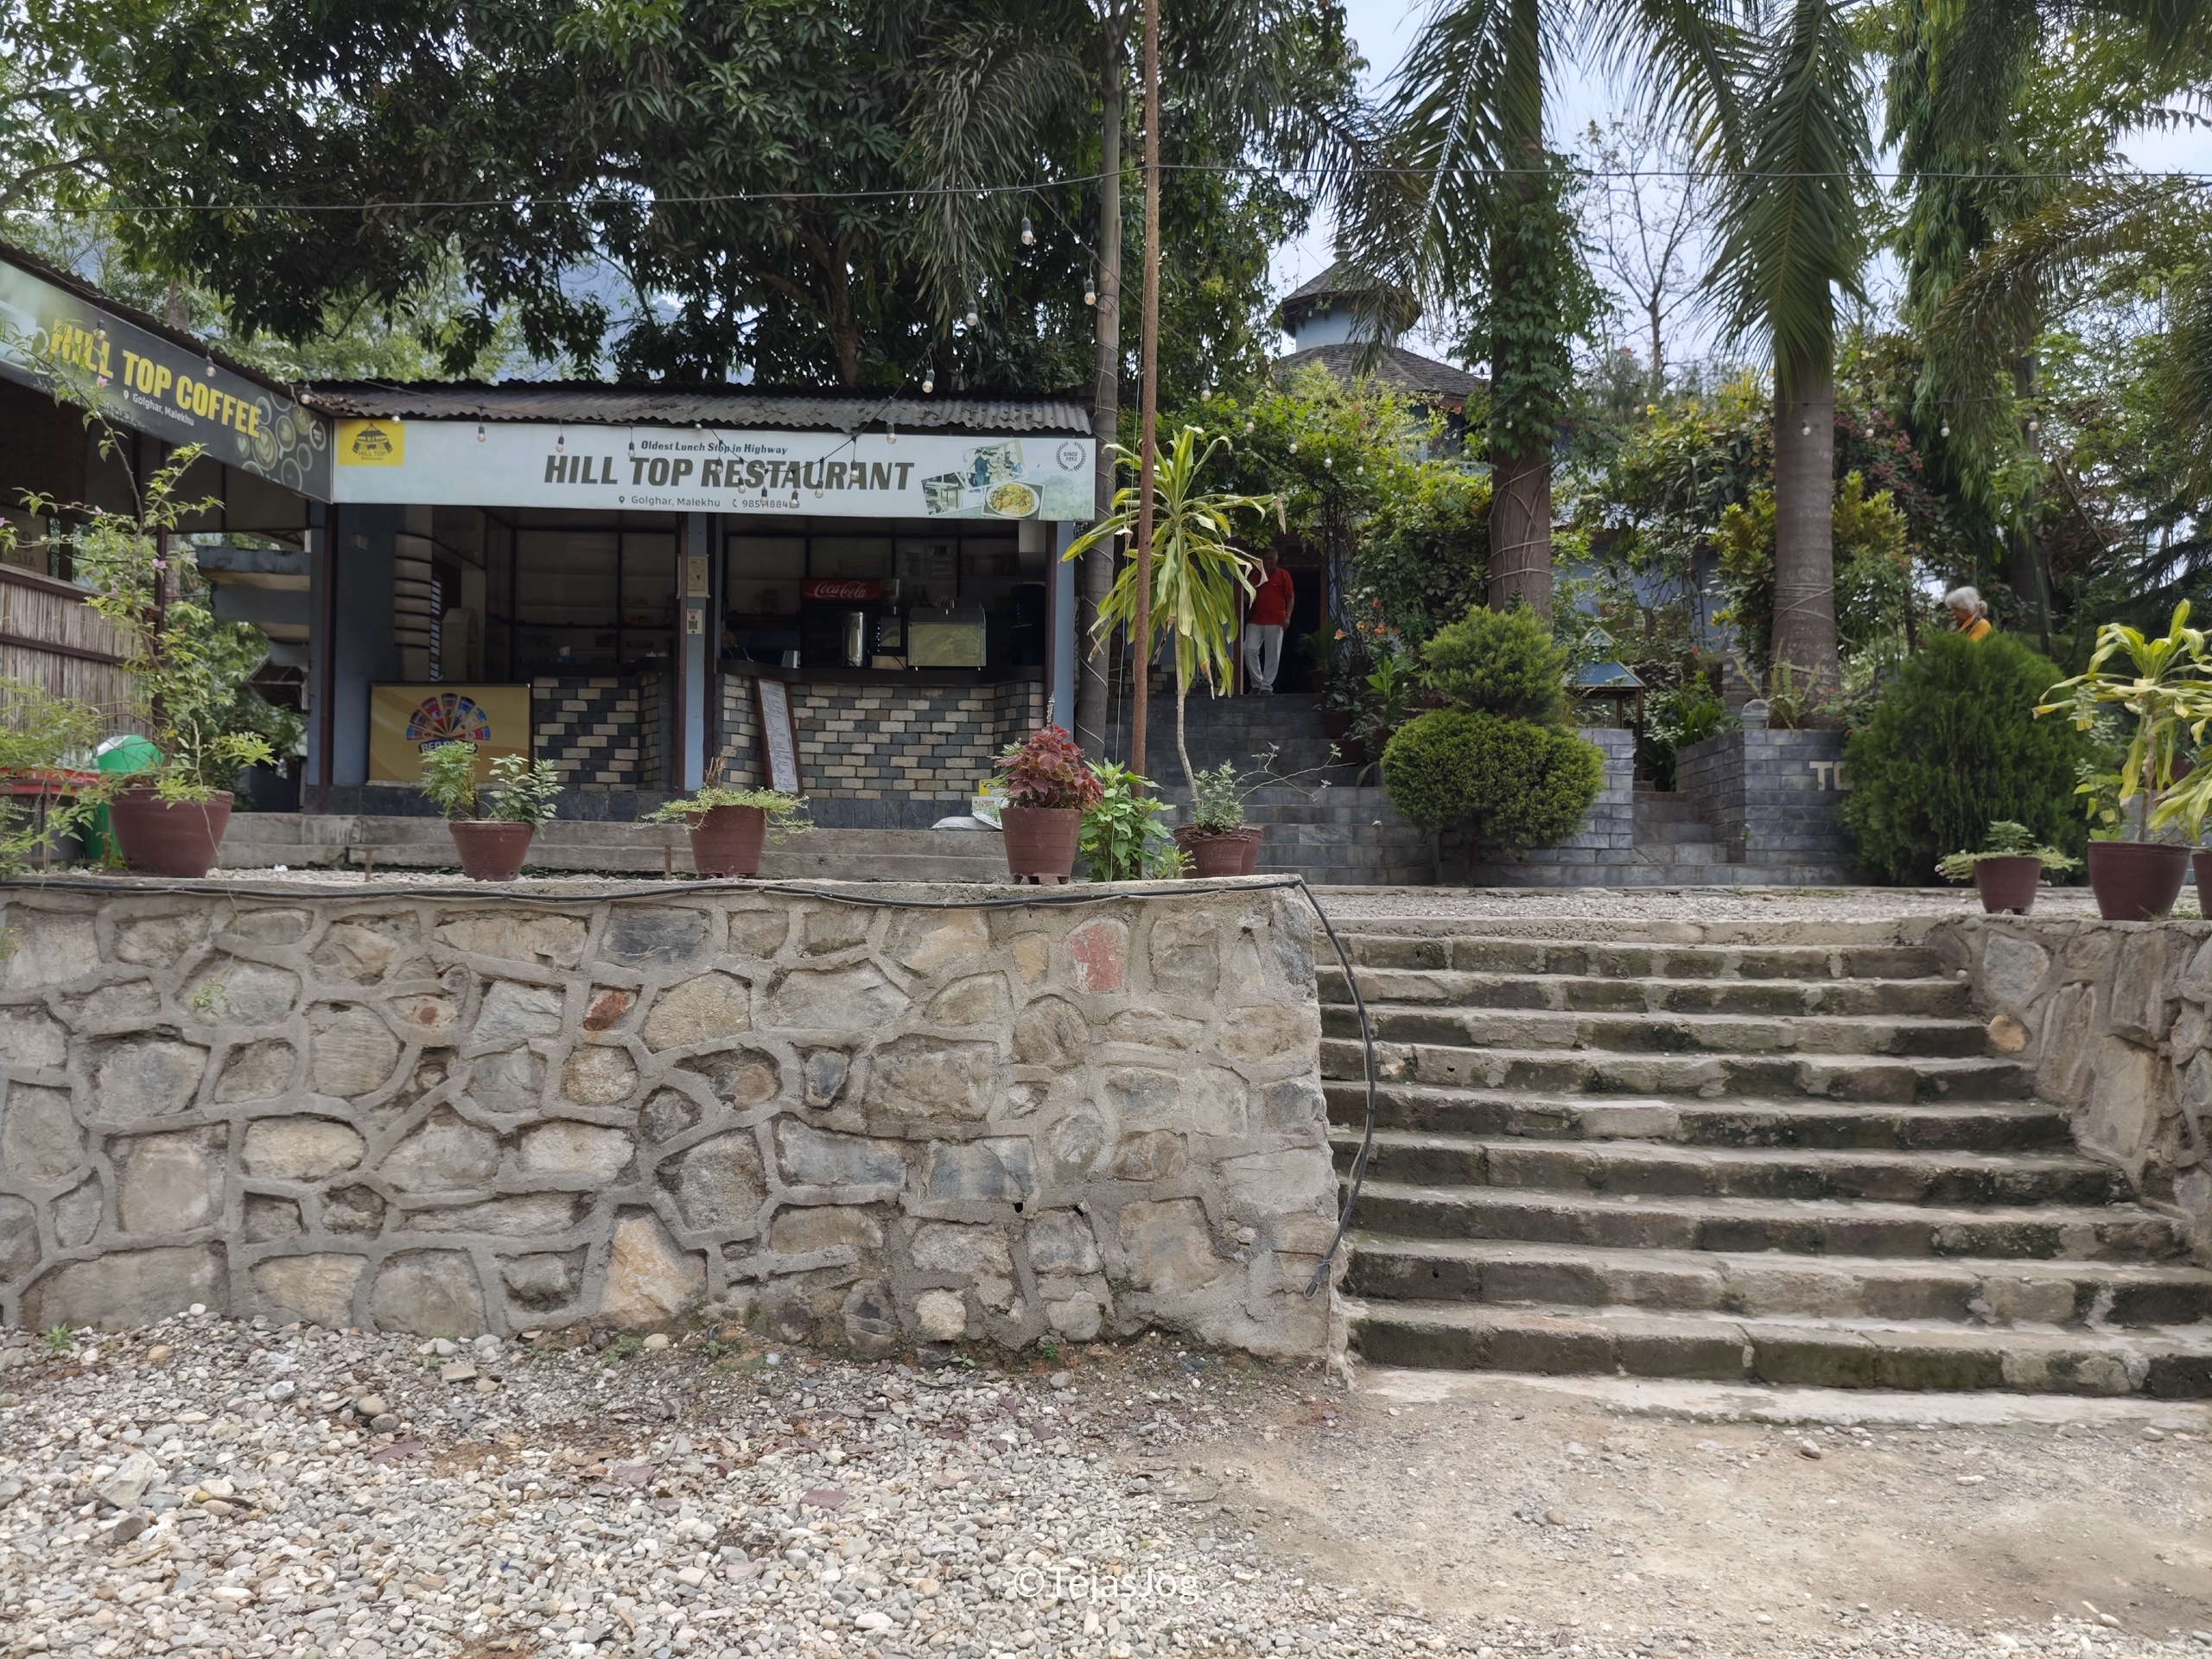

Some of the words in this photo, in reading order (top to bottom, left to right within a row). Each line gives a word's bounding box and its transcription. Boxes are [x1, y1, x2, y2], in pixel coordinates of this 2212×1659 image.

[50, 319, 113, 379] HILL
[123, 349, 172, 398] TOP
[176, 375, 262, 438] COFFEE
[132, 393, 164, 415] Golghar,
[164, 406, 194, 426] Malekhu
[641, 440, 673, 451] Oldest
[676, 442, 705, 452] Lunch
[708, 442, 730, 454] Stop
[733, 443, 741, 453] in
[744, 443, 788, 454] Highway
[543, 454, 619, 485] HILL
[629, 457, 694, 486] TOP
[700, 458, 915, 491] RESTAURANT
[631, 495, 675, 506] Golghar,
[677, 498, 721, 507] Malekhu
[814, 581, 868, 599] Coca-Cola
